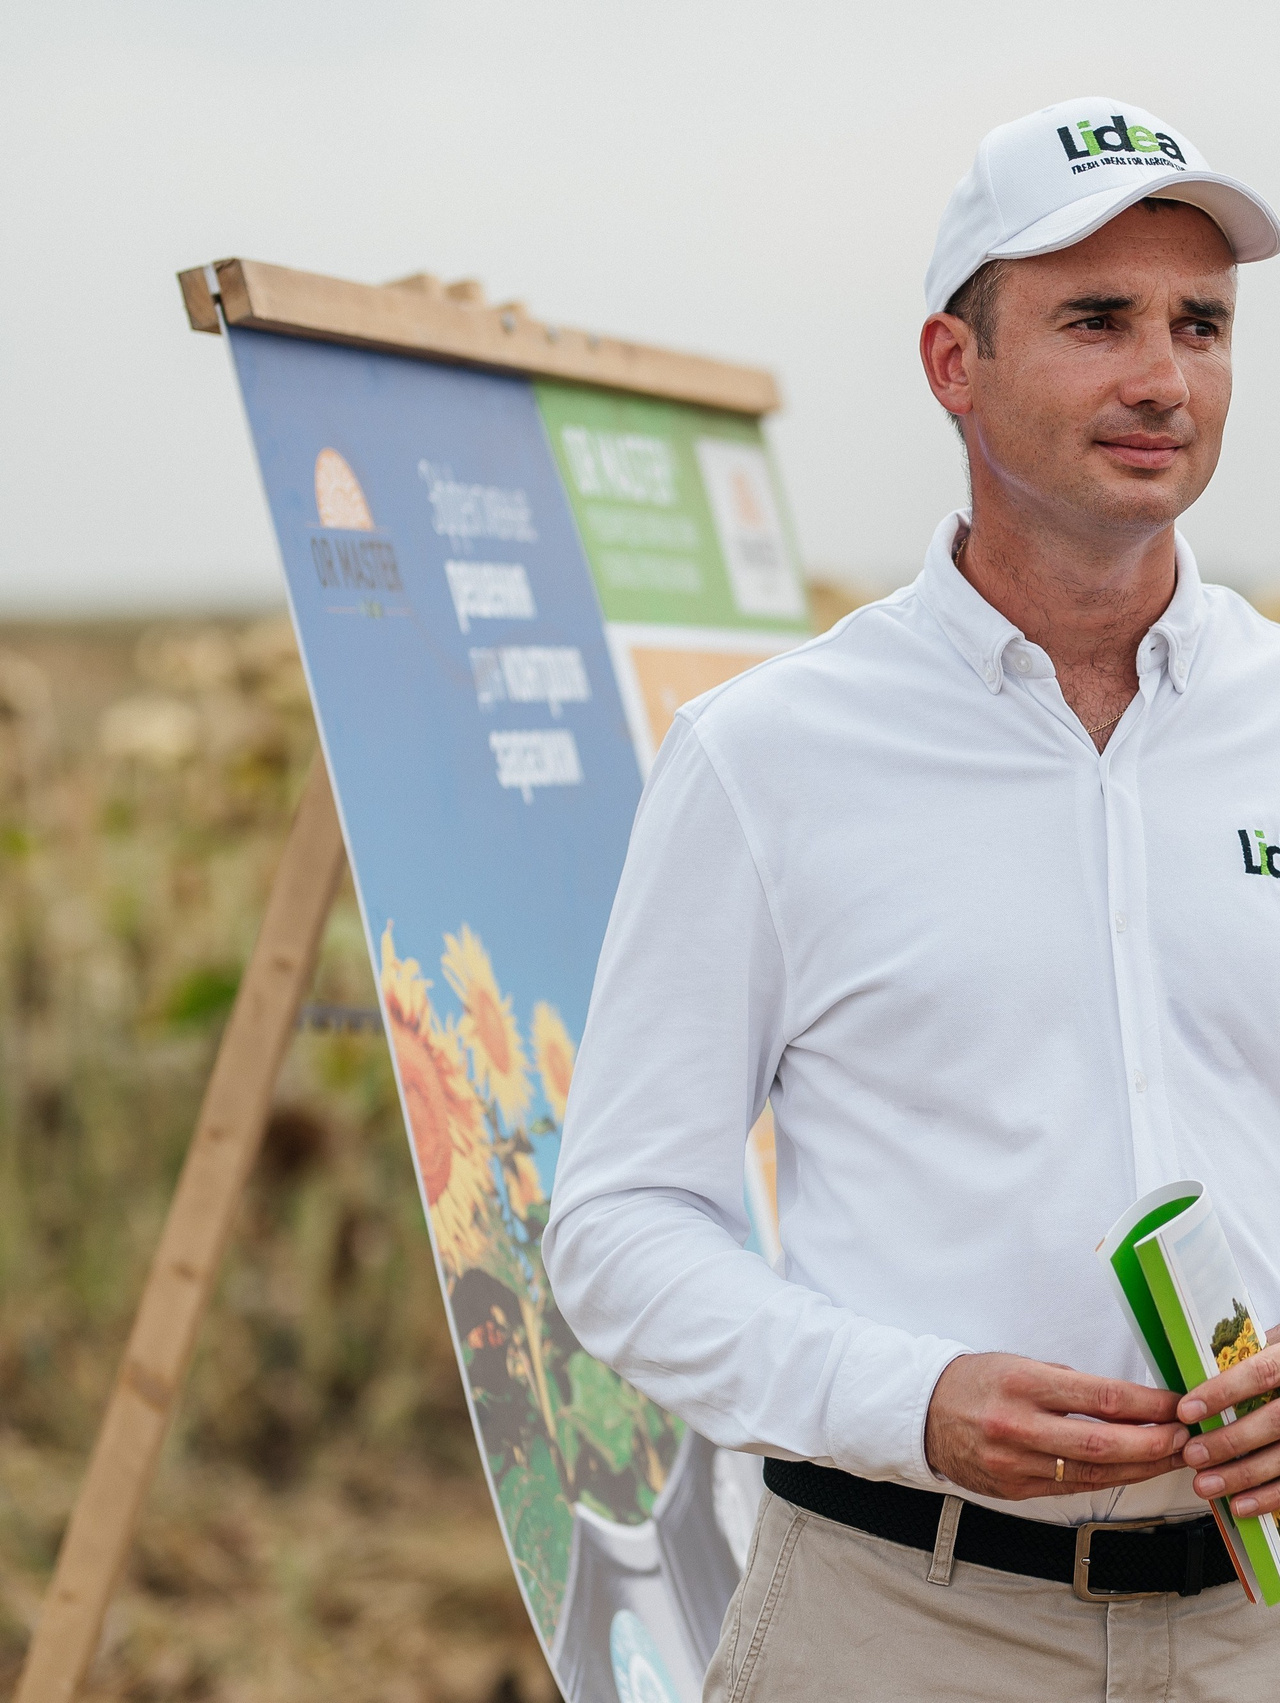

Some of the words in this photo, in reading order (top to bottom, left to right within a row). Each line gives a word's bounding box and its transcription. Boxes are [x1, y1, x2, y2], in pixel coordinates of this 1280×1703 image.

[1057, 115, 1187, 164] Lidea
[1071, 160, 1100, 175] FRESH
[1100, 156, 1127, 166] IDEAS
[1127, 156, 1145, 166] FOR
